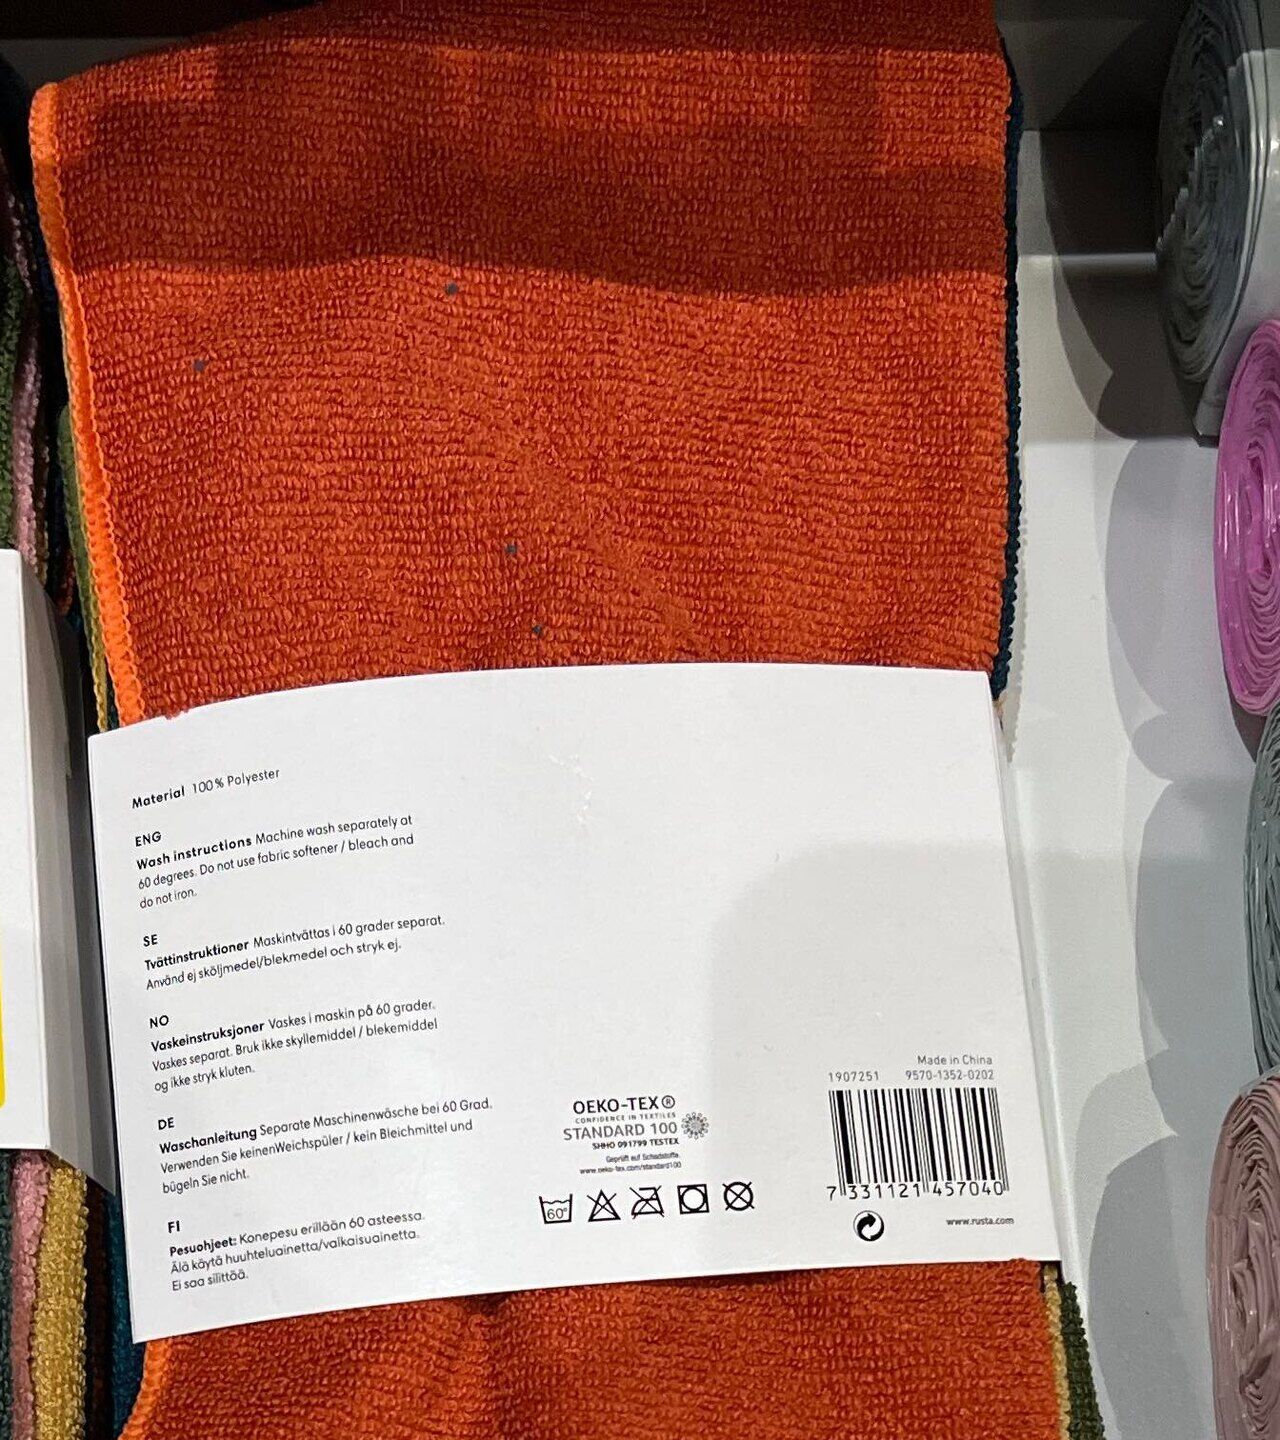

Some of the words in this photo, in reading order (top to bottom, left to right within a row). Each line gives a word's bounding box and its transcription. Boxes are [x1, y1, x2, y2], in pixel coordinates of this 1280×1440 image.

[132, 786, 184, 808] Material
[193, 778, 224, 793] 100%
[227, 768, 280, 786] Polyester
[136, 831, 161, 846] ENG
[136, 854, 170, 869] Wash
[174, 839, 252, 860] instructions
[256, 830, 303, 843] Machine
[307, 824, 334, 836] wash
[338, 817, 397, 832] separately
[153, 870, 196, 885] degrees.
[200, 864, 214, 875] Do
[217, 860, 234, 871] not
[237, 857, 255, 867] use
[258, 851, 290, 863] fabric
[293, 845, 338, 858] softener
[348, 837, 388, 850] bleach
[391, 834, 413, 846] and
[156, 893, 172, 904] not
[174, 889, 197, 899] iron.
[144, 934, 158, 947] SE
[144, 942, 249, 969] Tvättinstruktioner
[254, 929, 330, 947] Maskintvättas
[338, 924, 352, 935] 60
[356, 920, 394, 936] grader
[398, 916, 444, 929] separat.
[147, 971, 184, 990] Använd
[198, 947, 327, 983] sköljmedel/blekmedel
[330, 944, 354, 956] och
[357, 940, 384, 954] stryk
[150, 1015, 169, 1028] NO
[151, 1024, 264, 1051] Vaskeinstruksjoner
[268, 1016, 306, 1029] Vaskes
[315, 1009, 354, 1022] maskin
[358, 1005, 372, 1019] på
[376, 1003, 390, 1015] 60
[394, 1000, 436, 1016] grader.
[152, 1058, 187, 1071] Vaskes
[190, 1048, 232, 1064] separat.
[236, 1041, 259, 1055] Bruk
[262, 1039, 283, 1050] ikke
[286, 1028, 356, 1048] skyllemiddel
[366, 1019, 437, 1036] blekemiddel
[918, 1055, 946, 1065] Made
[962, 1055, 992, 1065] China
[171, 1076, 190, 1087] ikke
[193, 1069, 217, 1083] stryk
[219, 1066, 254, 1078] kluten.
[829, 1071, 878, 1082] 1907251
[906, 1070, 994, 1080] 9570-1352-0202
[158, 1117, 174, 1130] DE
[159, 1130, 256, 1153] Waschanleitung
[260, 1121, 310, 1136] Separate
[314, 1107, 418, 1126] Maschinenwäsche
[422, 1105, 439, 1114] bei
[442, 1101, 456, 1112] 60
[460, 1098, 492, 1110] Grad.
[564, 1124, 644, 1140] STANDARD
[650, 1122, 677, 1134] 100
[161, 1155, 219, 1173] Verwenden
[222, 1151, 237, 1162] Sie
[354, 1131, 376, 1142] kein
[380, 1123, 447, 1139] Bleichmittel
[450, 1119, 472, 1132] und
[163, 1178, 199, 1194] bügeln
[202, 1175, 217, 1186] Sie
[220, 1169, 248, 1182] nicht.
[848, 1184, 920, 1199] 331121
[933, 1181, 1004, 1196] 457040
[170, 1237, 236, 1256] Pesuohjeet:
[240, 1229, 297, 1244] Konepesu
[301, 1221, 346, 1234] erillään
[349, 1217, 364, 1228] 60
[368, 1213, 425, 1227] asteessa.
